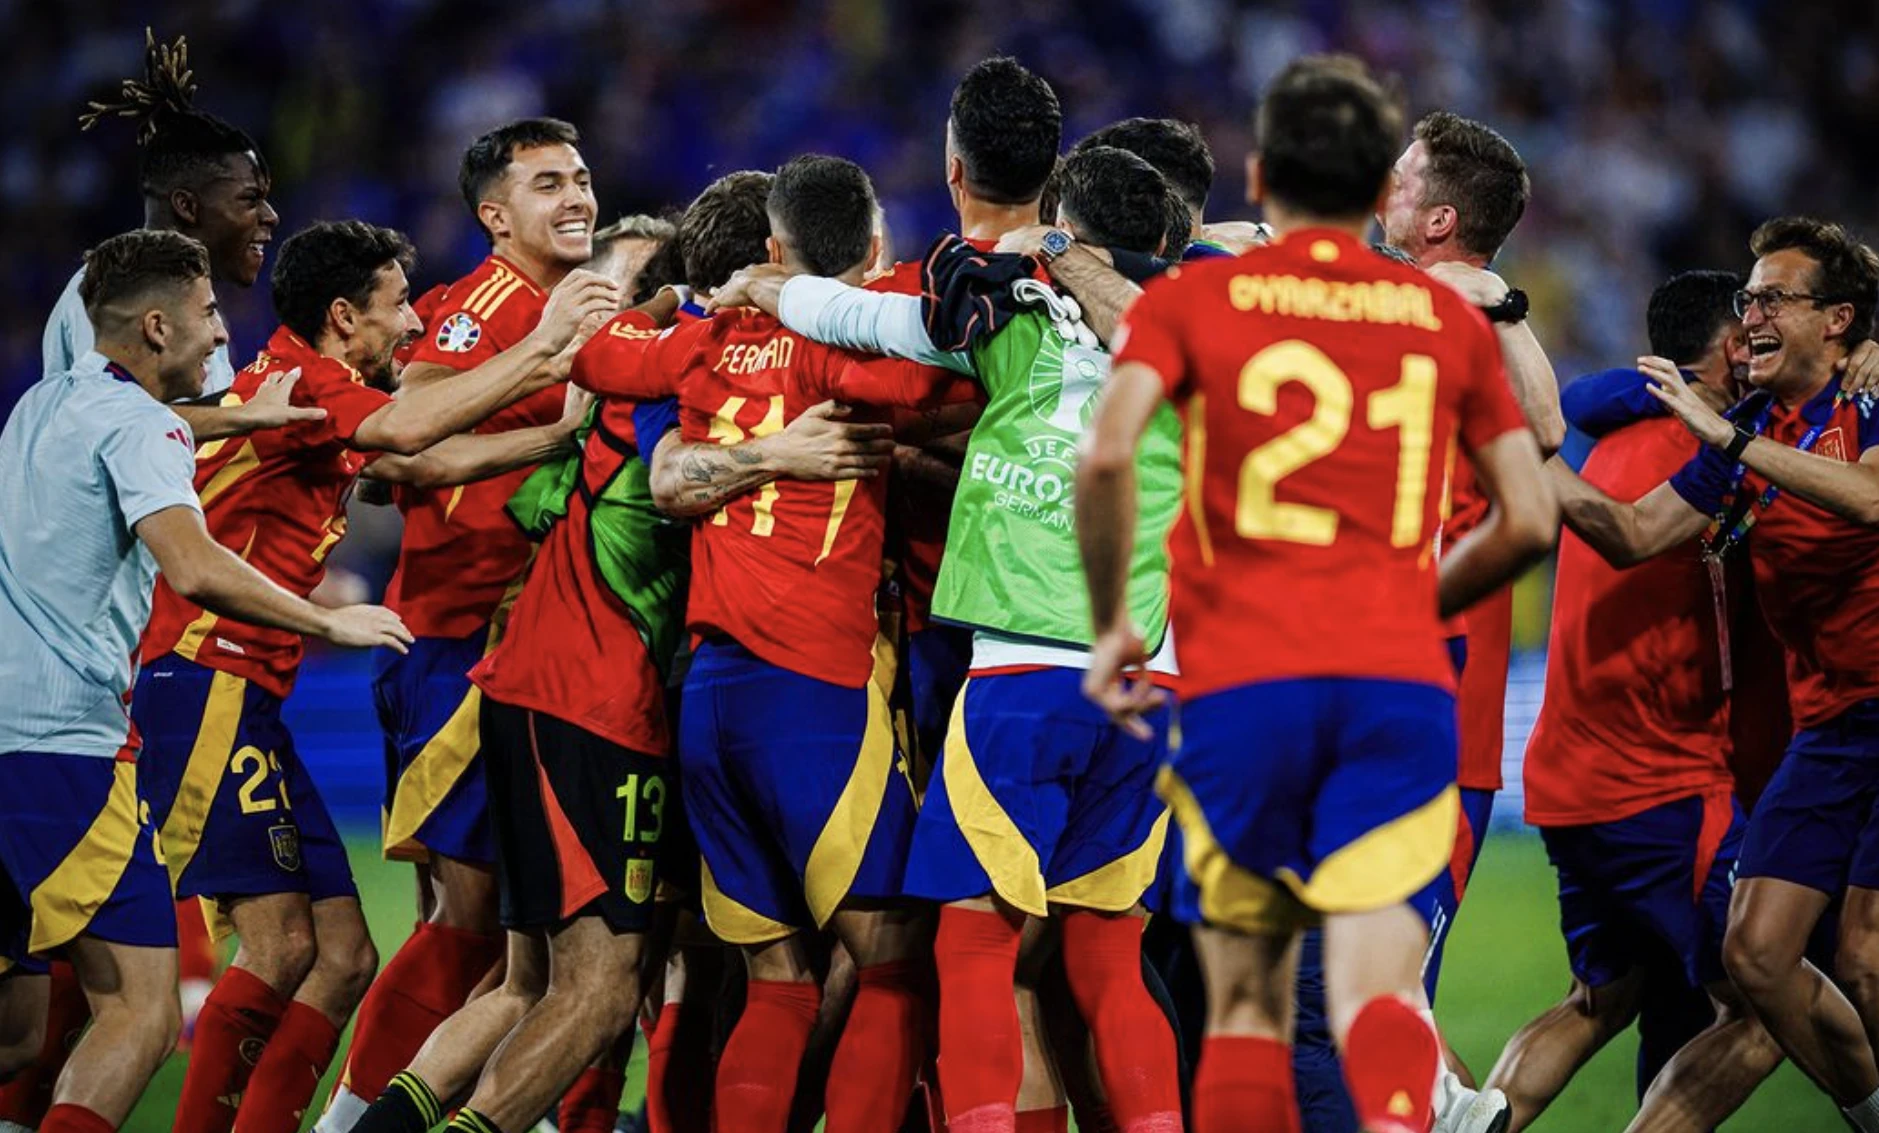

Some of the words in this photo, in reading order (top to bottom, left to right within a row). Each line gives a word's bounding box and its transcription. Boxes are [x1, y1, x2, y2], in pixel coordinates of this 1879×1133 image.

[1228, 274, 1443, 332] OYARZABAL
[1026, 440, 1077, 459] UEF
[1235, 338, 1438, 549] 21
[994, 489, 1075, 532] GERMAN
[616, 773, 666, 842] 13
